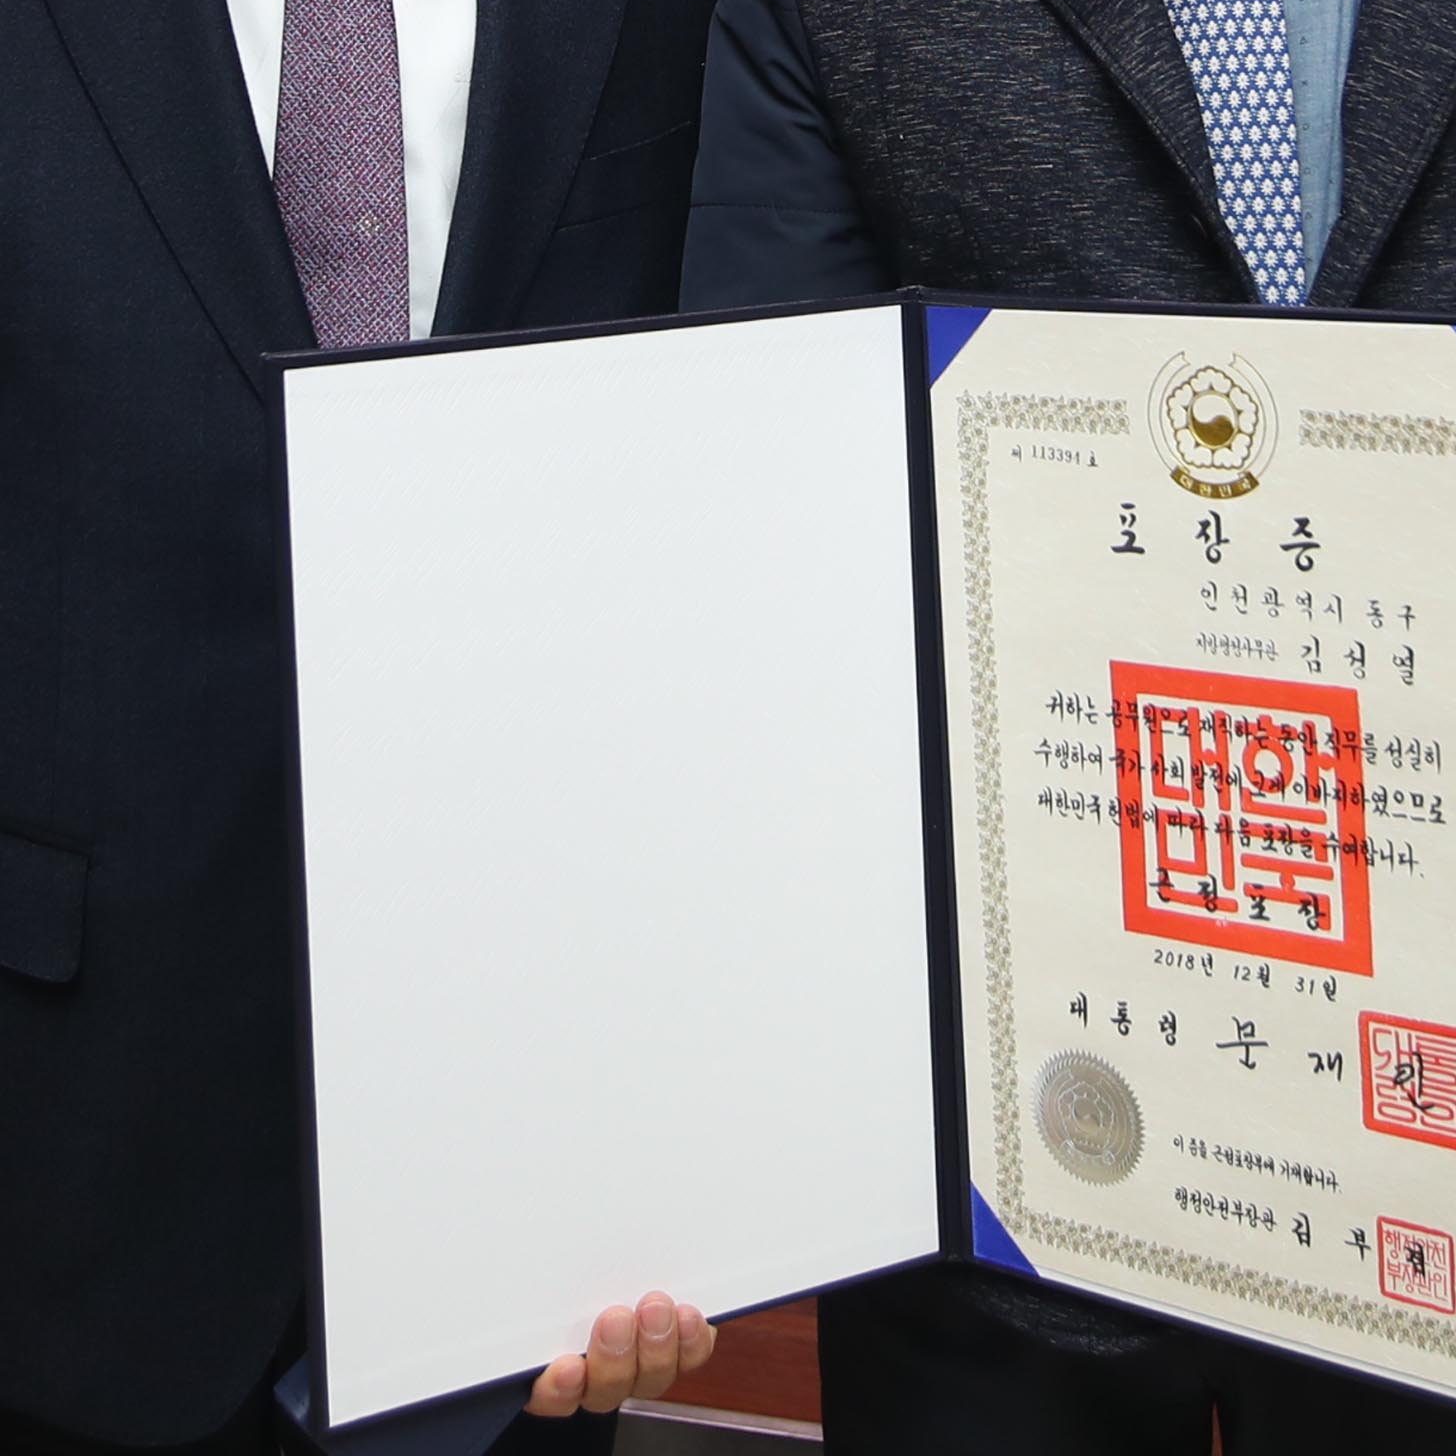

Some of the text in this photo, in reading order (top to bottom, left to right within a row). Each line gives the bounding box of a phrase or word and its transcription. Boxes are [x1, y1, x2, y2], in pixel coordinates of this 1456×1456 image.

[1199, 580, 1416, 632] 인천광역시 동구
[1045, 689, 1442, 775] 귀하는 공무원으로 재직하는 동안 직무를 성실히
[1033, 738, 1103, 776] 수행하여
[1190, 758, 1243, 794] 발전에
[1292, 773, 1447, 825] 이바지하였으므로
[1037, 785, 1102, 825] 대한민국
[1107, 796, 1160, 833] 헌법에
[1167, 805, 1209, 846] 따라
[1213, 815, 1252, 848] 다음
[1153, 948, 1338, 1002] 2018년 12월 31일
[1069, 991, 1178, 1047] 대통령
[1173, 1134, 1185, 1154] 이
[1174, 1185, 1278, 1232] 행정안전부장관
